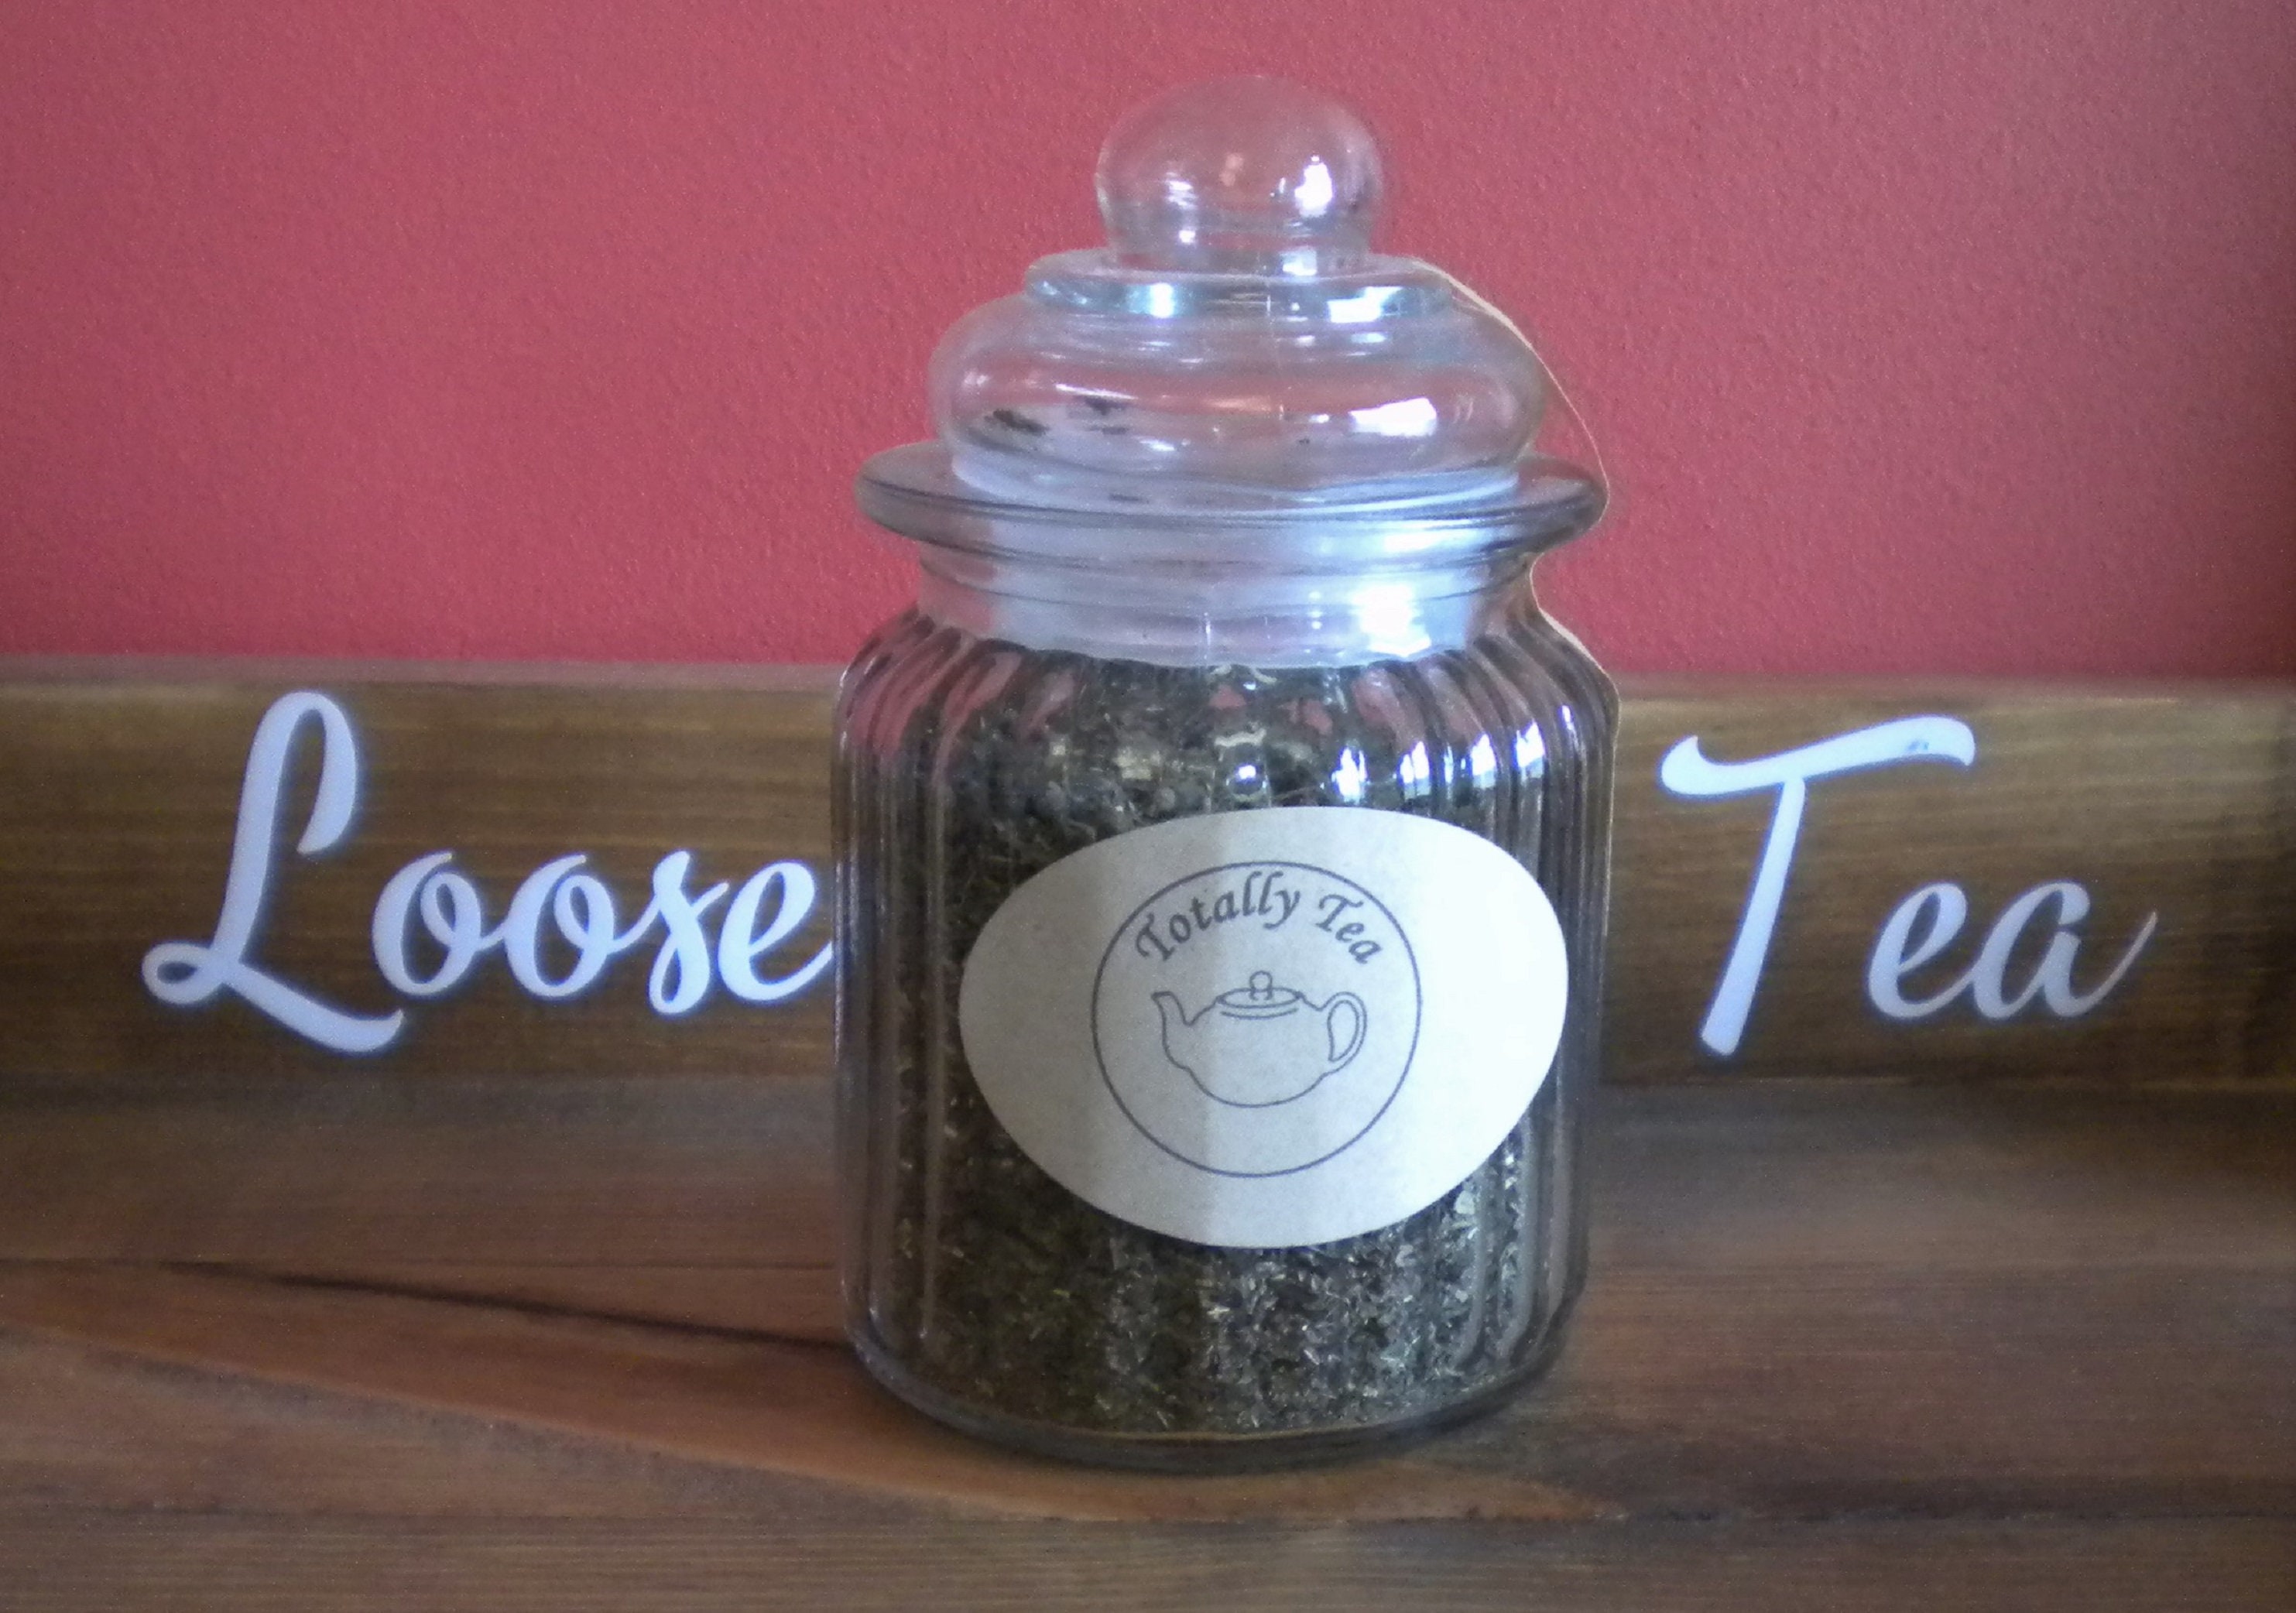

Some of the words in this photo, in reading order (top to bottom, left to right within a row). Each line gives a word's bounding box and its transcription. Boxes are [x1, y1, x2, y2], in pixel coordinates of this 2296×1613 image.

[141, 690, 834, 1056] Loose
[1660, 715, 2158, 1057] Tea
[1133, 871, 1301, 961] Totally
[1315, 894, 1383, 964] Tea
